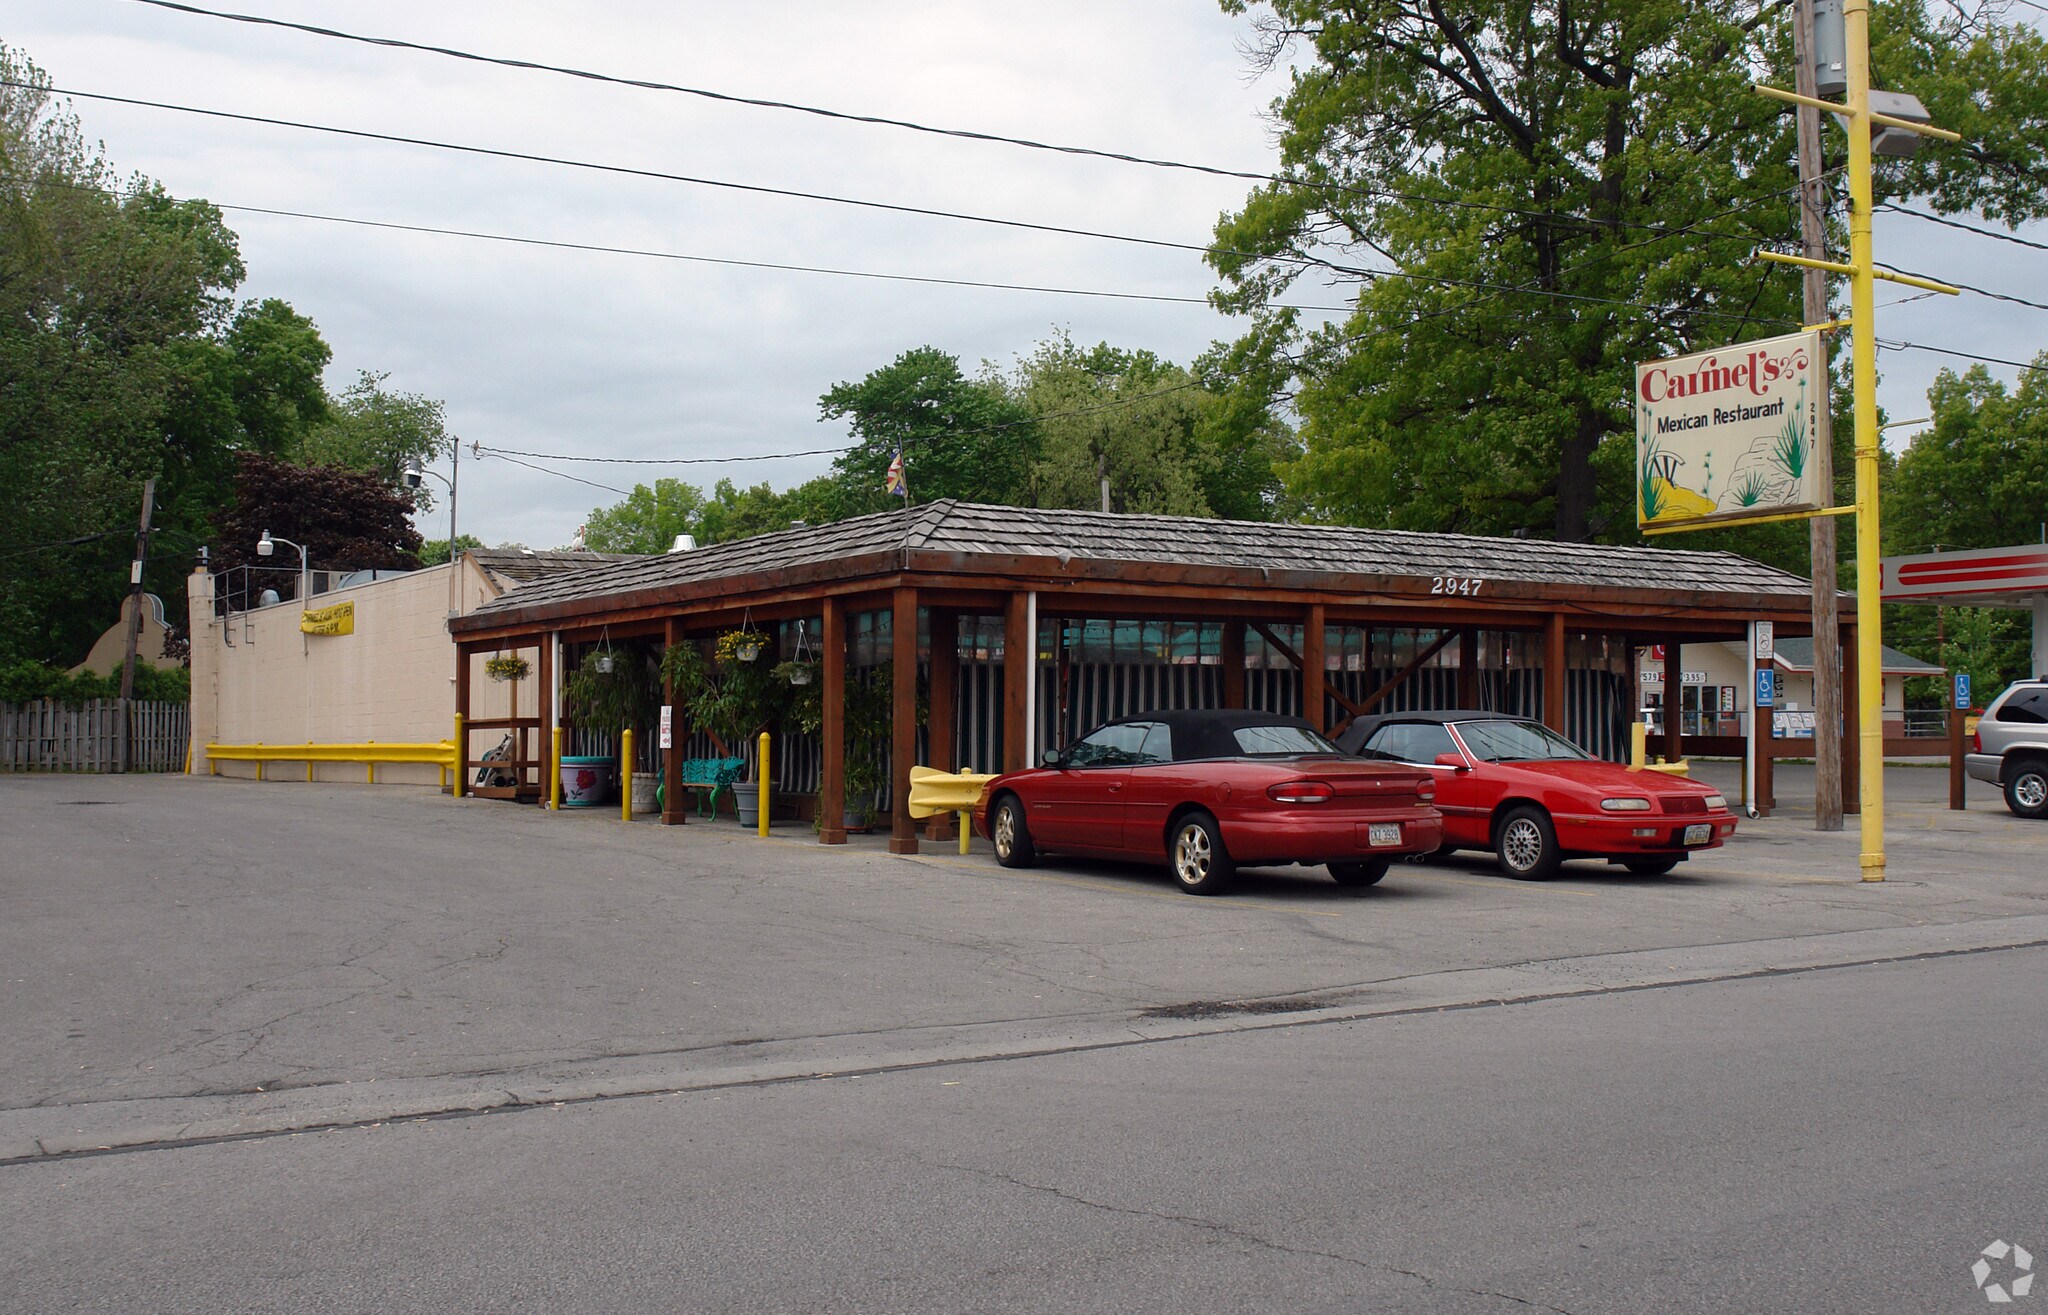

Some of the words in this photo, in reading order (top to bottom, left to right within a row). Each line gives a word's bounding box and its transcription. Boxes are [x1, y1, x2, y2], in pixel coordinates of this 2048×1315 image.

[1641, 350, 1781, 403] Carmel's
[1657, 413, 1708, 434] Mexican
[1713, 397, 1784, 425] Restaurant
[1431, 576, 1483, 596] 2947
